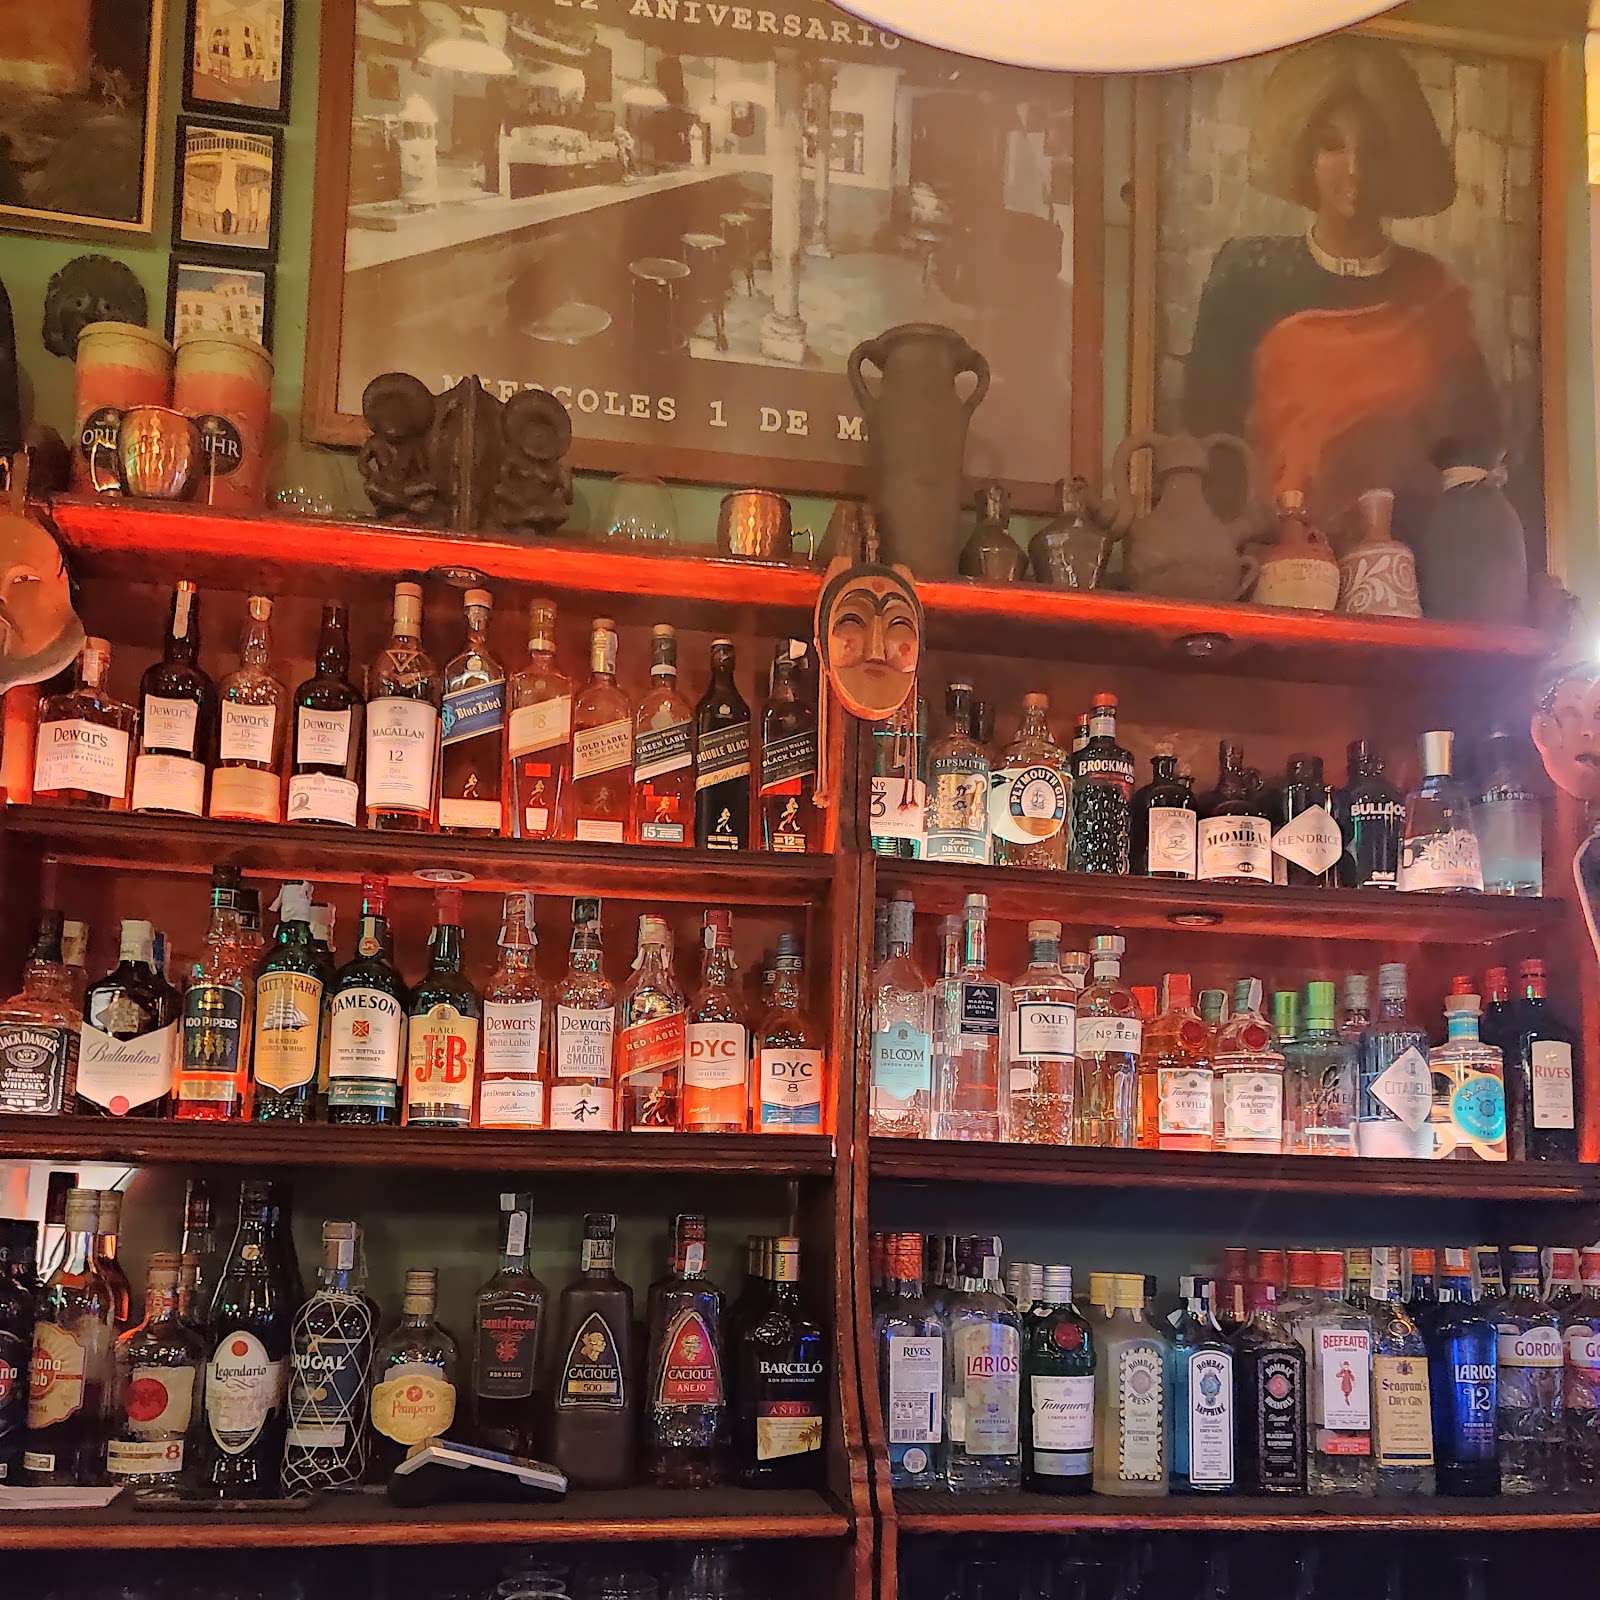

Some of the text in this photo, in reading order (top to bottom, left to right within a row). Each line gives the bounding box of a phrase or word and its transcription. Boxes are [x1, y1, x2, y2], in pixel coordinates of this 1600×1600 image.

[709, 401, 729, 427] 1
[760, 408, 808, 436] DE
[455, 704, 478, 720] Blue
[477, 697, 502, 714] Label
[226, 711, 269, 728] Dewar's
[303, 718, 345, 733] Dewar's
[53, 727, 109, 749] Dewar's
[240, 729, 251, 739] 15
[372, 728, 425, 739] MACALLAN
[576, 740, 600, 753] GOLD
[600, 733, 629, 748] LABEL
[581, 741, 627, 759] RESERVE
[636, 741, 663, 755] GREEN
[664, 733, 691, 746] LABEL
[388, 750, 404, 762] 12
[697, 745, 725, 764] DOUBLE
[762, 747, 815, 768] BLACK LABEL
[935, 757, 986, 769] SIPSMITH
[1010, 769, 1065, 809] PLYMOUTH GIN
[1350, 801, 1406, 818] BULLDOG
[643, 826, 656, 838] 15
[783, 836, 795, 846] 12
[942, 845, 960, 853] DRY
[1431, 860, 1459, 871] GIN
[289, 977, 319, 997] SARK
[333, 994, 397, 1018] JAMESON
[966, 1003, 995, 1012] MILLER'S
[185, 1017, 239, 1029] 100 PIPERS
[486, 1017, 536, 1032] Dewar's
[561, 1016, 612, 1032] Dewar's
[1030, 1013, 1069, 1025] OXLEY
[430, 1026, 457, 1034] RARE
[0, 1031, 61, 1054] JACK DANIEL'S
[488, 1038, 531, 1047] White Label
[583, 1036, 590, 1046] 8
[626, 1038, 647, 1052] RED
[649, 1029, 681, 1045] LABEL
[566, 1045, 606, 1055] JAPANESE
[690, 1040, 737, 1058] DYC
[880, 1048, 925, 1062] BLOOM
[566, 1053, 605, 1065] SMOOTH
[4, 1068, 45, 1079] Tennessee
[771, 1062, 813, 1077] DYC
[1534, 1065, 1571, 1079] RIVES
[1, 1081, 48, 1091] WHISKEY
[787, 1083, 799, 1093] 8
[1322, 1334, 1369, 1351] BEEFEATER
[902, 1346, 931, 1358] RIVES
[215, 1362, 267, 1383] Legendario
[568, 1367, 618, 1380] CACIQUE
[759, 1359, 823, 1376] BARCELÓ
[966, 1356, 1019, 1378] LARIOS
[1128, 1359, 1156, 1373] BOMBAY
[1195, 1359, 1225, 1374] BOMBAY
[1264, 1363, 1294, 1378] BOMBAY
[667, 1369, 715, 1381] CACIQUE
[1454, 1364, 1497, 1384] LARIOS
[583, 1382, 602, 1392] 500
[1381, 1378, 1427, 1394] Seagram's
[1264, 1397, 1295, 1411] BRAMBLE
[1388, 1395, 1424, 1406] DRY GIN
[1462, 1385, 1491, 1411] 12
[392, 1400, 436, 1420] Pampero
[769, 1404, 811, 1416] AÑEJO
[1194, 1402, 1227, 1416] SAPPHIRE
[165, 1444, 181, 1460] 8
